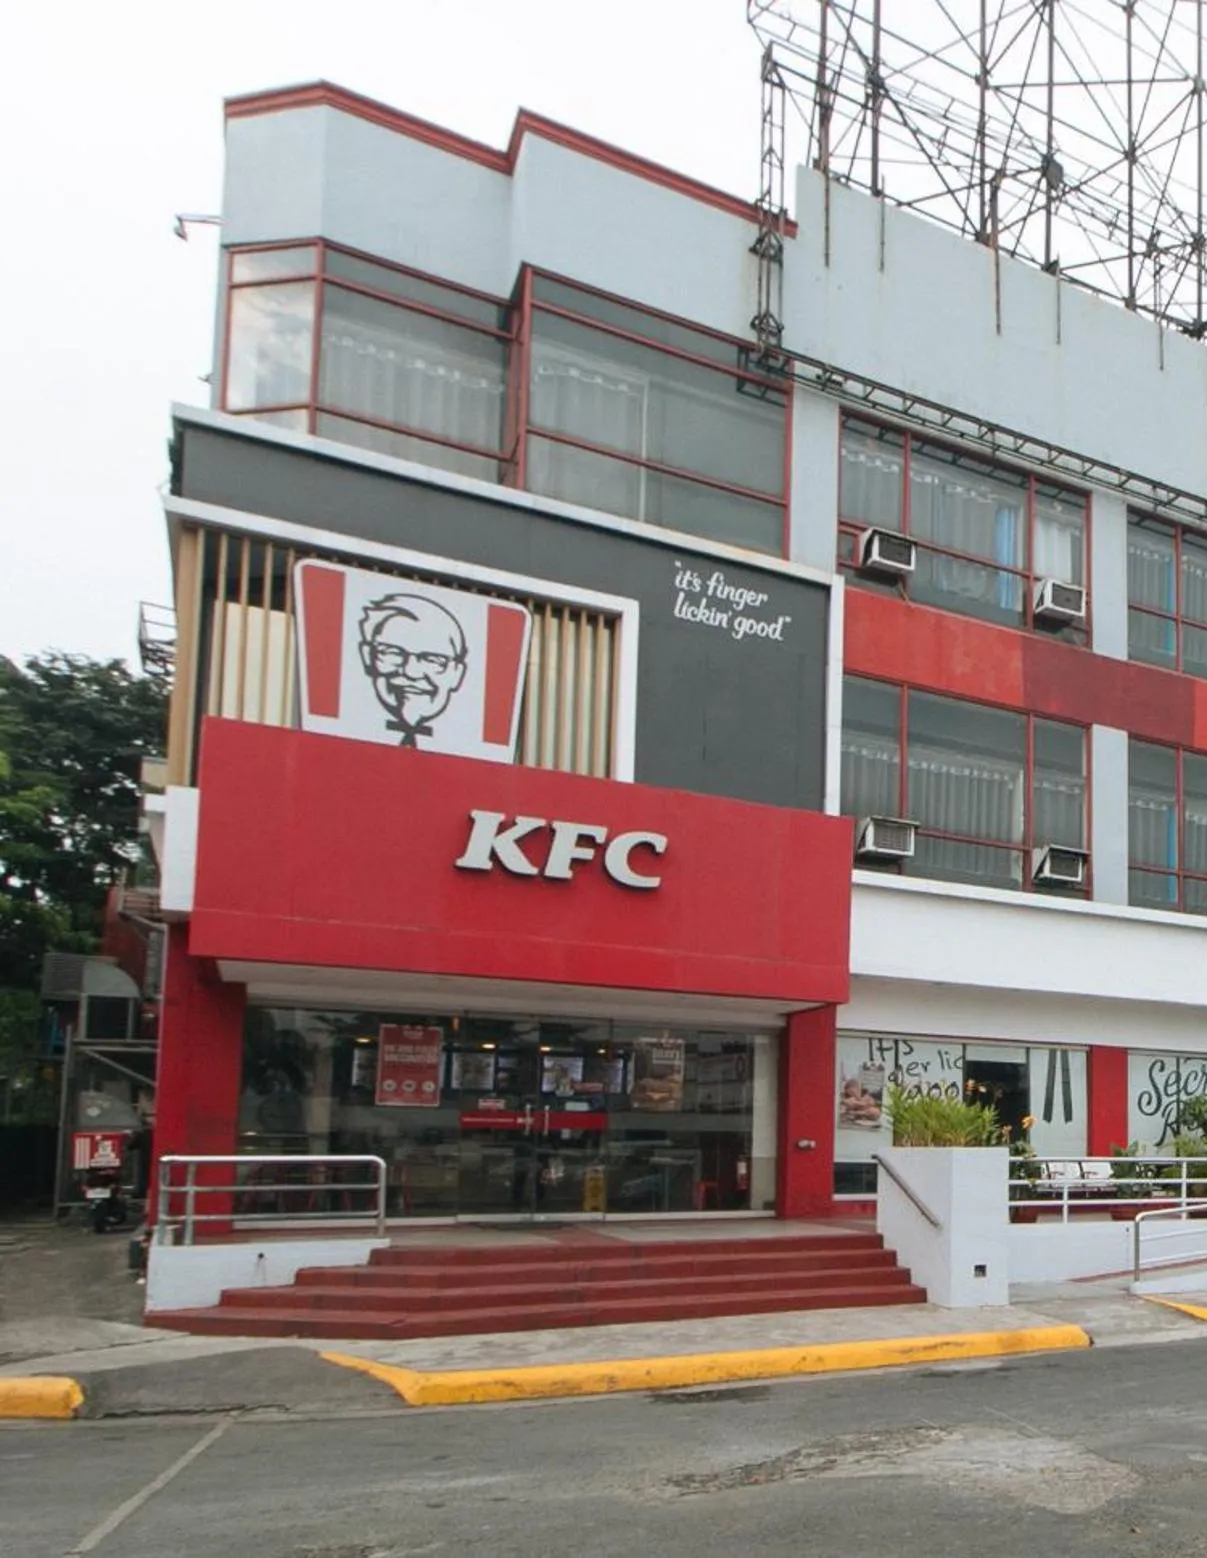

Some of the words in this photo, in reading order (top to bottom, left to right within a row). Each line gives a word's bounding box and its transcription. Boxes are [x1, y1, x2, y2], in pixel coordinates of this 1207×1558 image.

[673, 591, 733, 629] lickin'
[706, 571, 769, 611] finger
[454, 808, 669, 888] KFC
